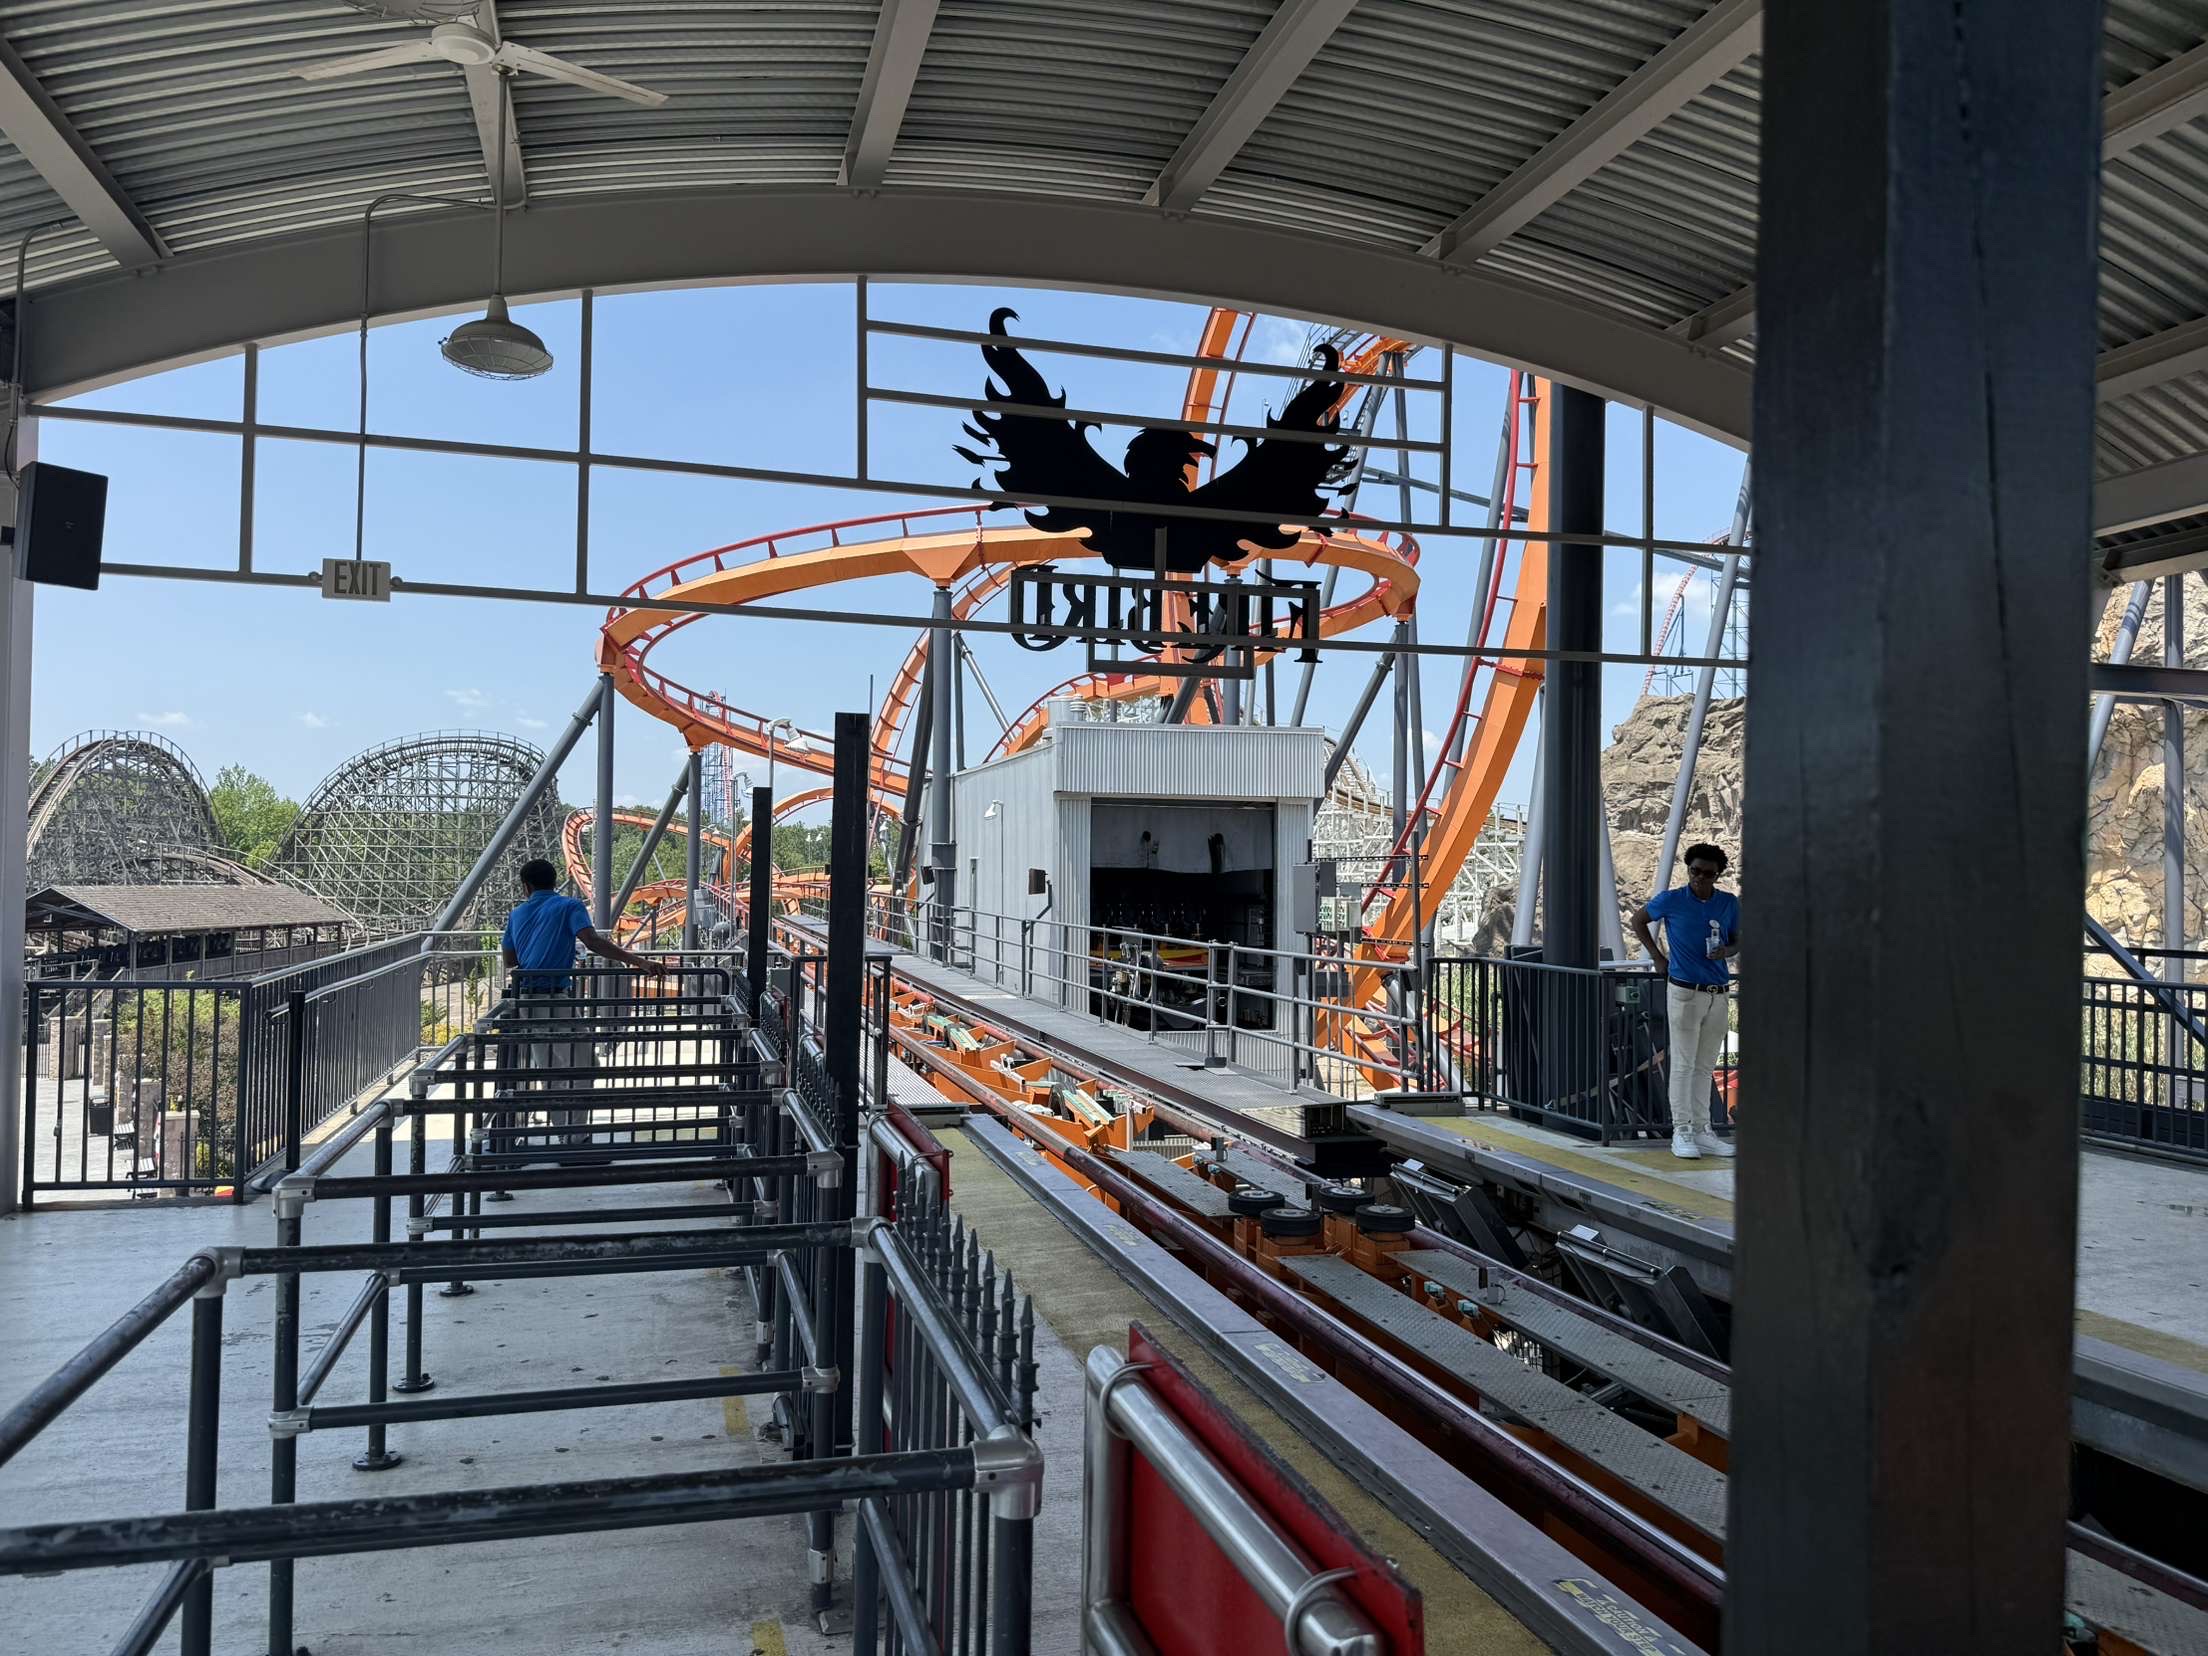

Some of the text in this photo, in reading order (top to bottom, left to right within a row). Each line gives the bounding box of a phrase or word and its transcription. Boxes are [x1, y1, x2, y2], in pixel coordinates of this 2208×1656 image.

[334, 560, 381, 595] EXIT
[1604, 1614, 1633, 1635] YOUR
[1606, 1605, 1650, 1635] CAUTION
